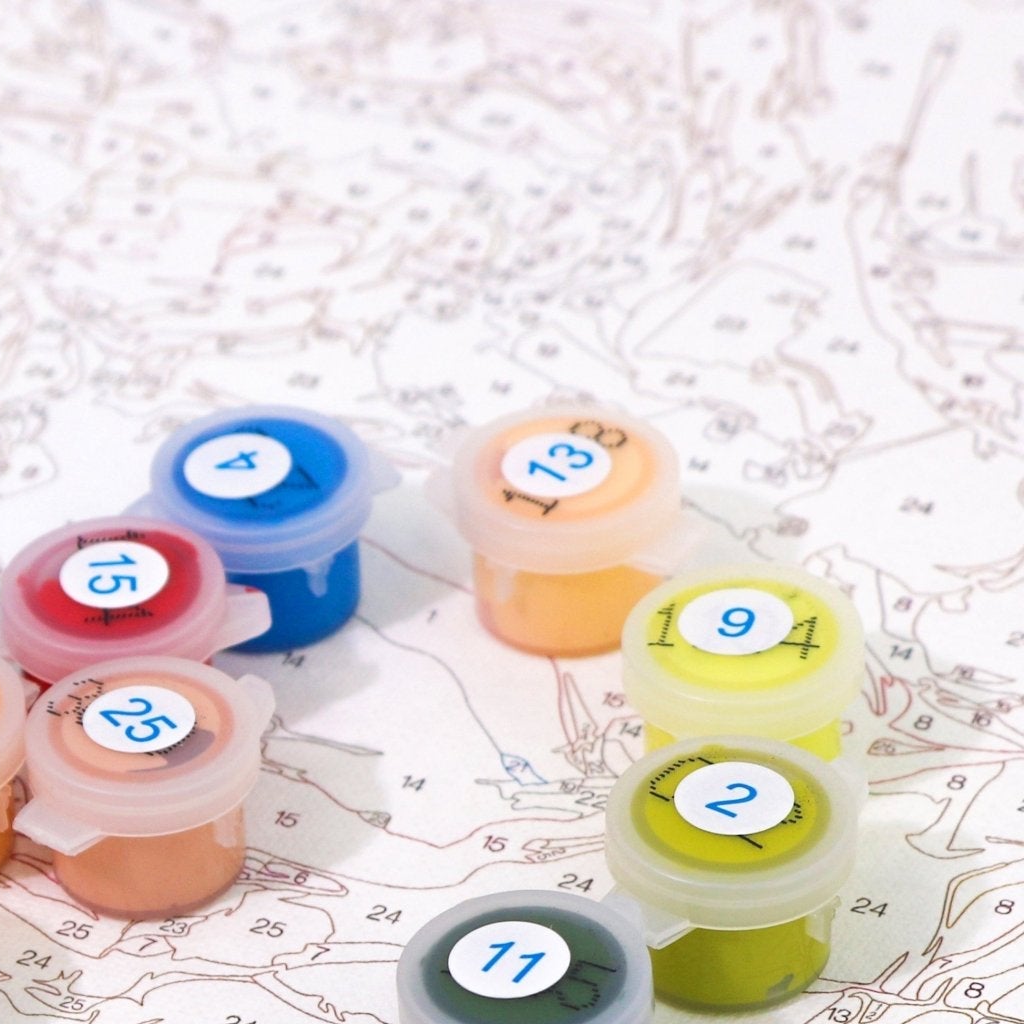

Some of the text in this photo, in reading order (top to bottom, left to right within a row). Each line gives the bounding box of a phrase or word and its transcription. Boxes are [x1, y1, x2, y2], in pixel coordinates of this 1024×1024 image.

[217, 452, 256, 470] 4
[529, 445, 593, 480] 13
[89, 555, 136, 594] 15
[718, 608, 755, 637] 9
[281, 653, 305, 669] 14
[890, 645, 913, 660] 14
[603, 692, 625, 707] 15
[100, 698, 176, 742] 25
[914, 715, 933, 731] 8
[620, 722, 642, 738] 14
[403, 776, 425, 791] 14
[947, 775, 967, 790] 8
[706, 783, 757, 817] 2
[275, 811, 297, 828] 15
[483, 835, 508, 852] 15
[294, 872, 308, 885] 6
[558, 874, 594, 892] 24
[366, 905, 402, 924] 24
[850, 898, 888, 917] 24
[995, 900, 1015, 914] 8
[56, 921, 93, 940] 25
[159, 918, 188, 935] 23
[249, 918, 286, 937] 25
[139, 938, 158, 951] 7
[311, 945, 331, 961] 7
[16, 950, 52, 969] 24
[483, 942, 544, 983] 11
[939, 957, 953, 969] 7
[964, 982, 984, 998] 8
[59, 996, 83, 1010] 25
[827, 1006, 852, 1023] 13
